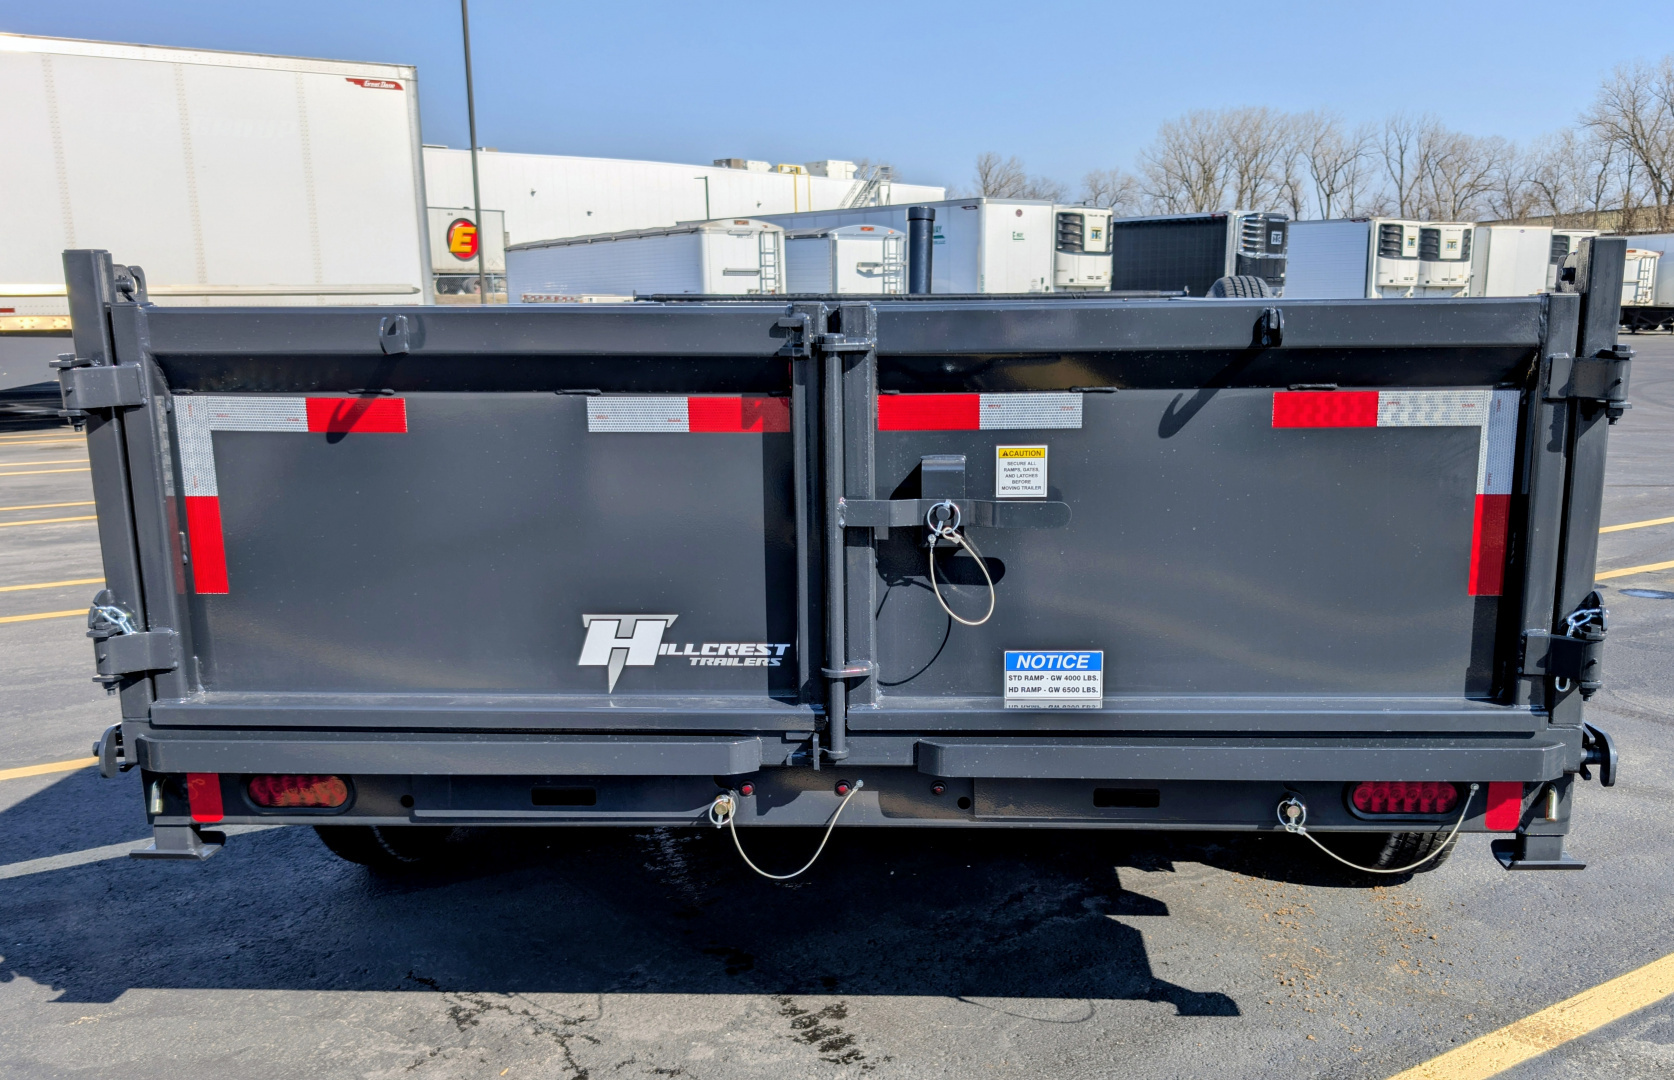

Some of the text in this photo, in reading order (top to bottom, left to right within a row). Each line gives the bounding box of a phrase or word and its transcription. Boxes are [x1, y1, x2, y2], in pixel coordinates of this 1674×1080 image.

[449, 226, 477, 253] E
[689, 656, 783, 667] TRAILERS
[1016, 654, 1091, 670] NOTICE
[1008, 674, 1023, 682] STD
[1024, 674, 1045, 682] RAMP
[1050, 674, 1063, 682] GW
[1063, 674, 1081, 682] 4000
[1083, 674, 1099, 682] LBS.
